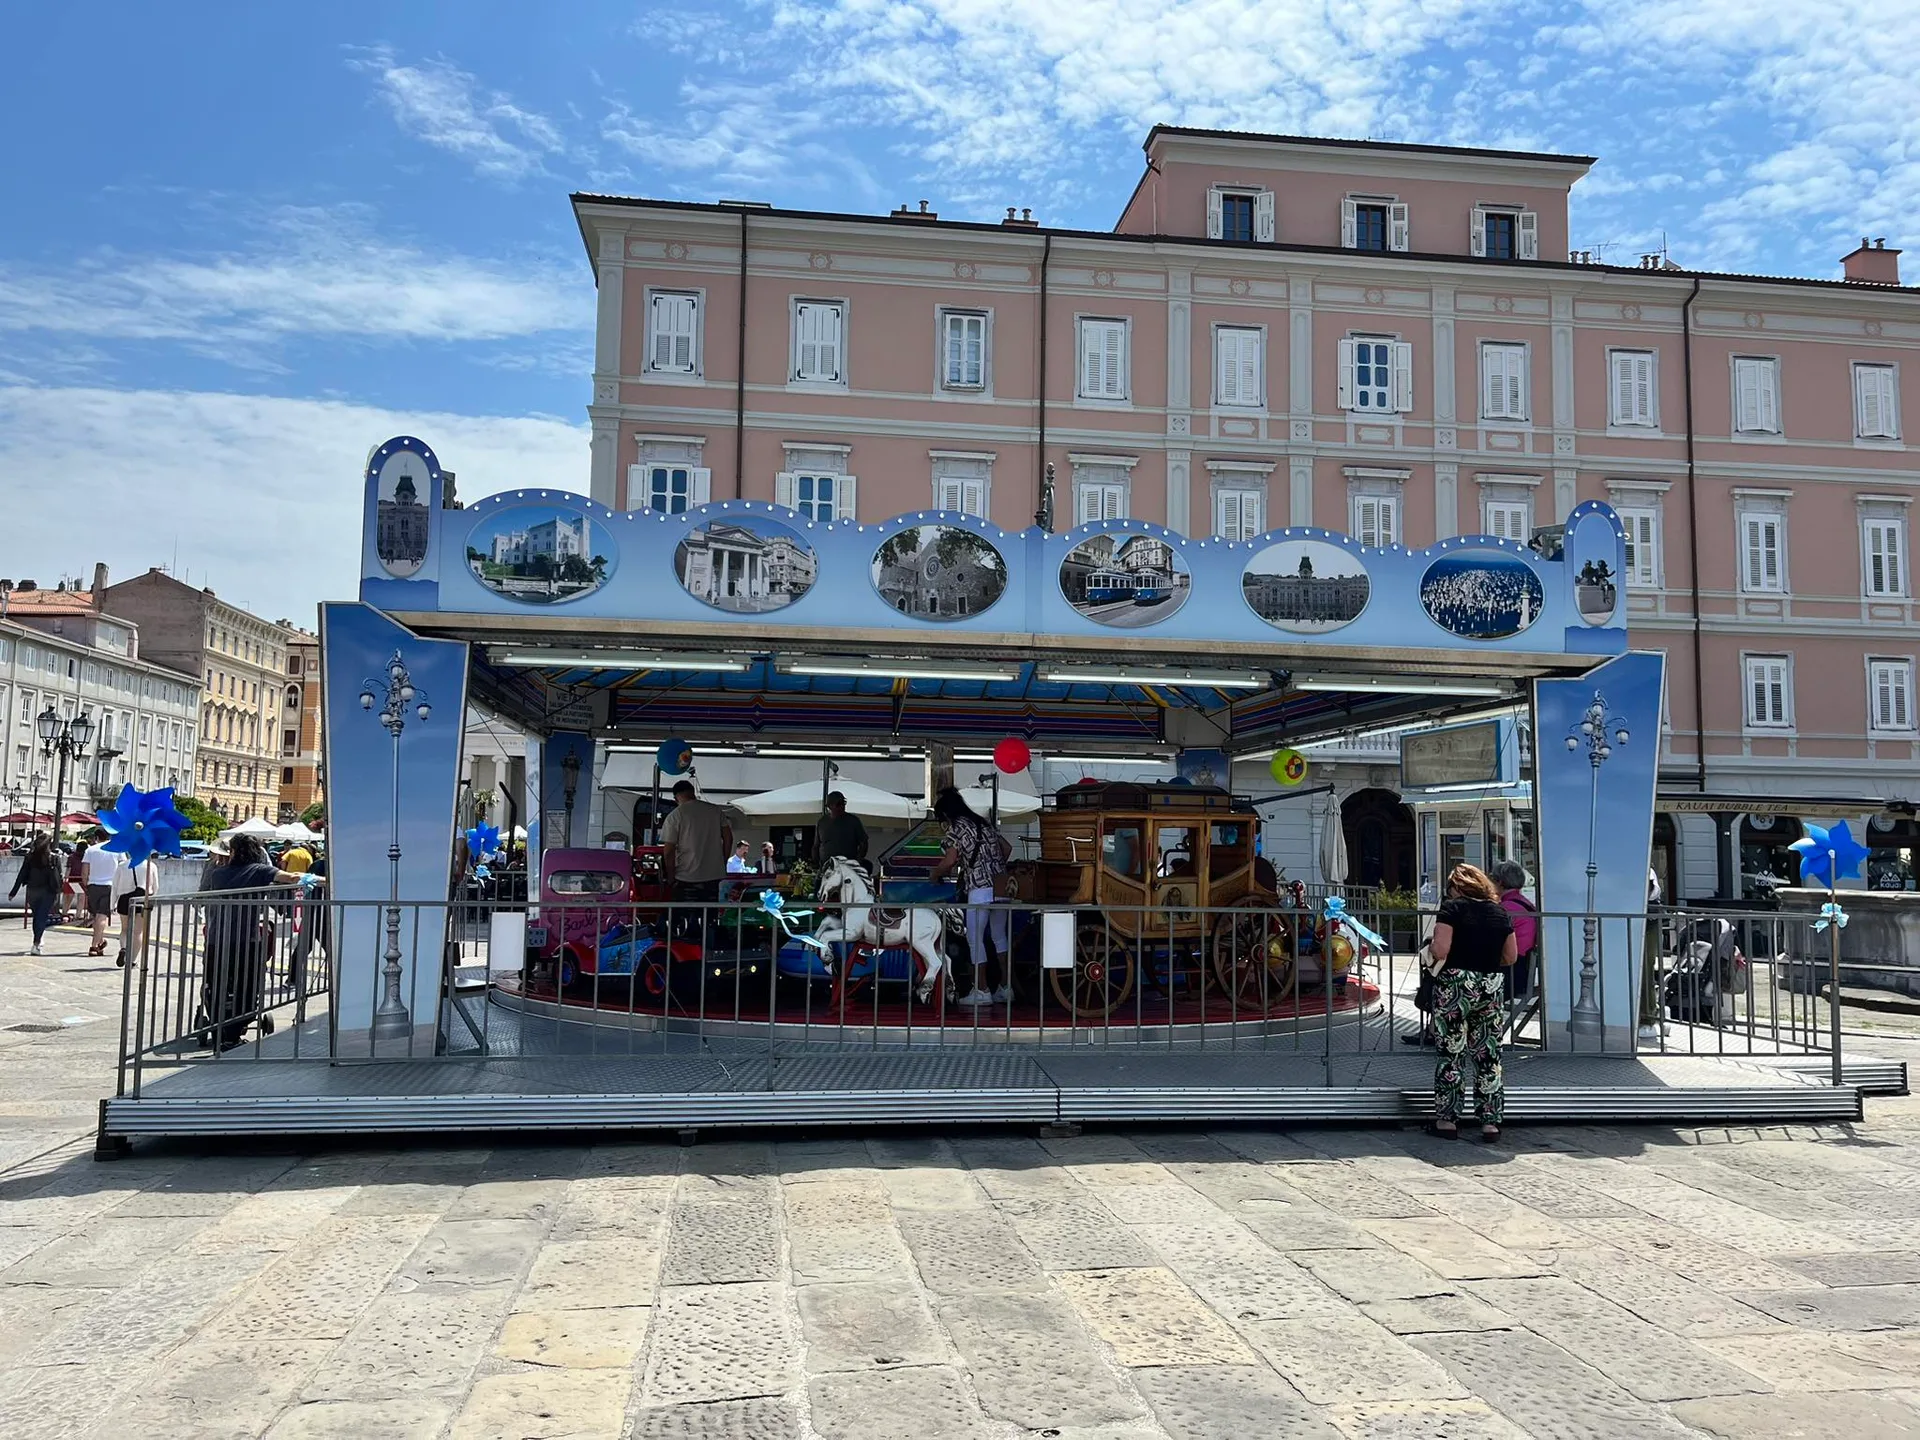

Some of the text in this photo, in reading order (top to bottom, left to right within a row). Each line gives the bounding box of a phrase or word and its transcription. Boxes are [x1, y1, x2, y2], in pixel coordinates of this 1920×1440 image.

[1675, 802, 1714, 811] KAUAI
[1717, 802, 1764, 812] BUBBLE
[1767, 804, 1789, 812] TEA
